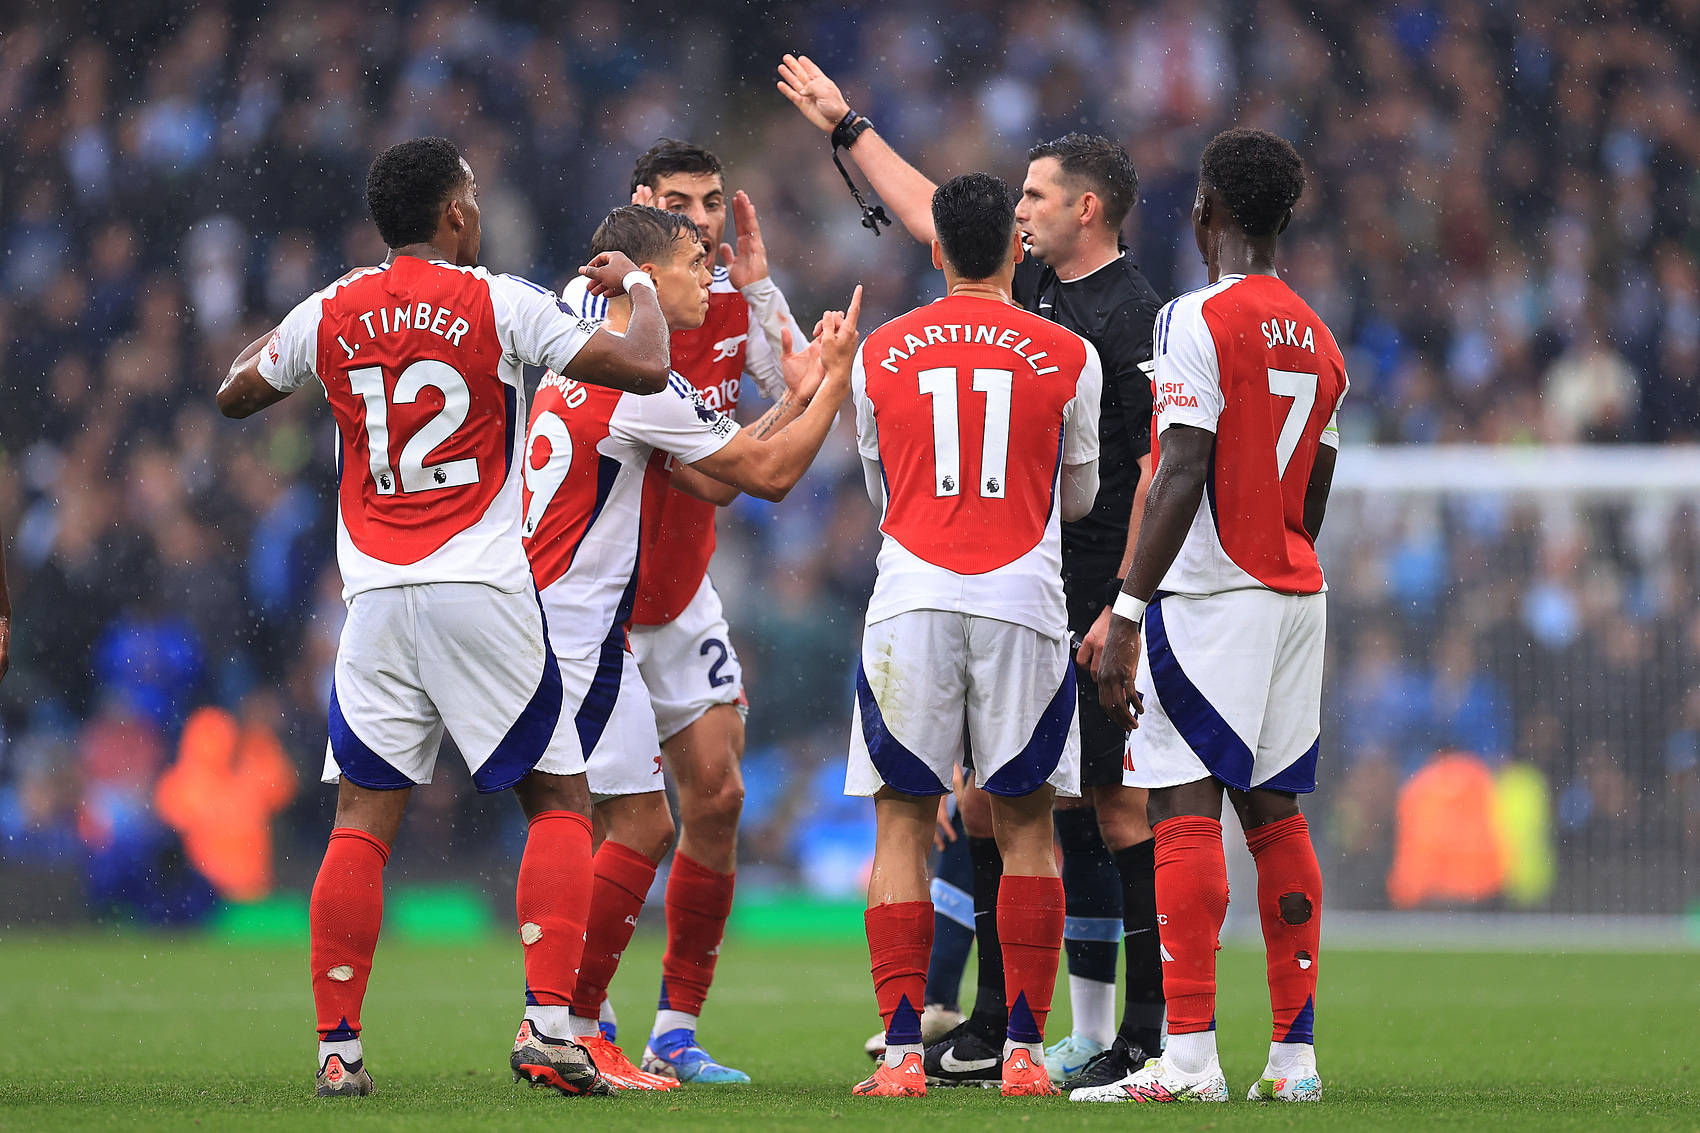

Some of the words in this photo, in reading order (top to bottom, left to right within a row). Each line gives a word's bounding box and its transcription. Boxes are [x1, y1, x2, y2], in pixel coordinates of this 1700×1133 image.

[337, 335, 360, 360] J.
[359, 302, 470, 347] TIMBER
[880, 324, 1060, 376] MARTINELLI
[1261, 320, 1316, 354] SAKA
[348, 359, 480, 496] 12
[918, 367, 1014, 499] 11
[1267, 367, 1319, 482] 7
[700, 638, 739, 688] 2
